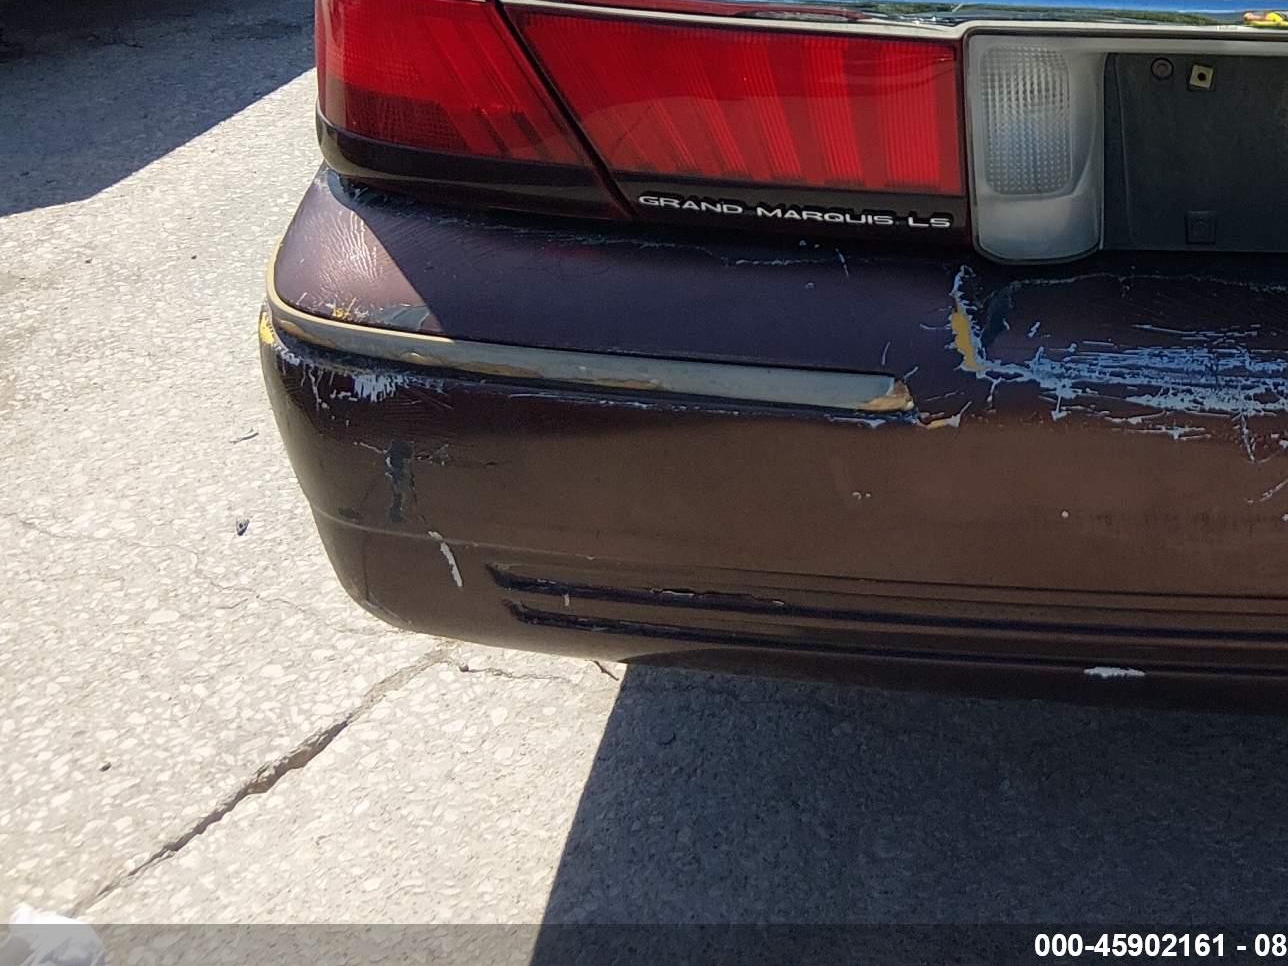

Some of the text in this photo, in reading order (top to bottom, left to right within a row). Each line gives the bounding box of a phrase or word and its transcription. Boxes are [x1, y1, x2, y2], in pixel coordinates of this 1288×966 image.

[638, 195, 951, 229] GRAND MARQUIS LS
